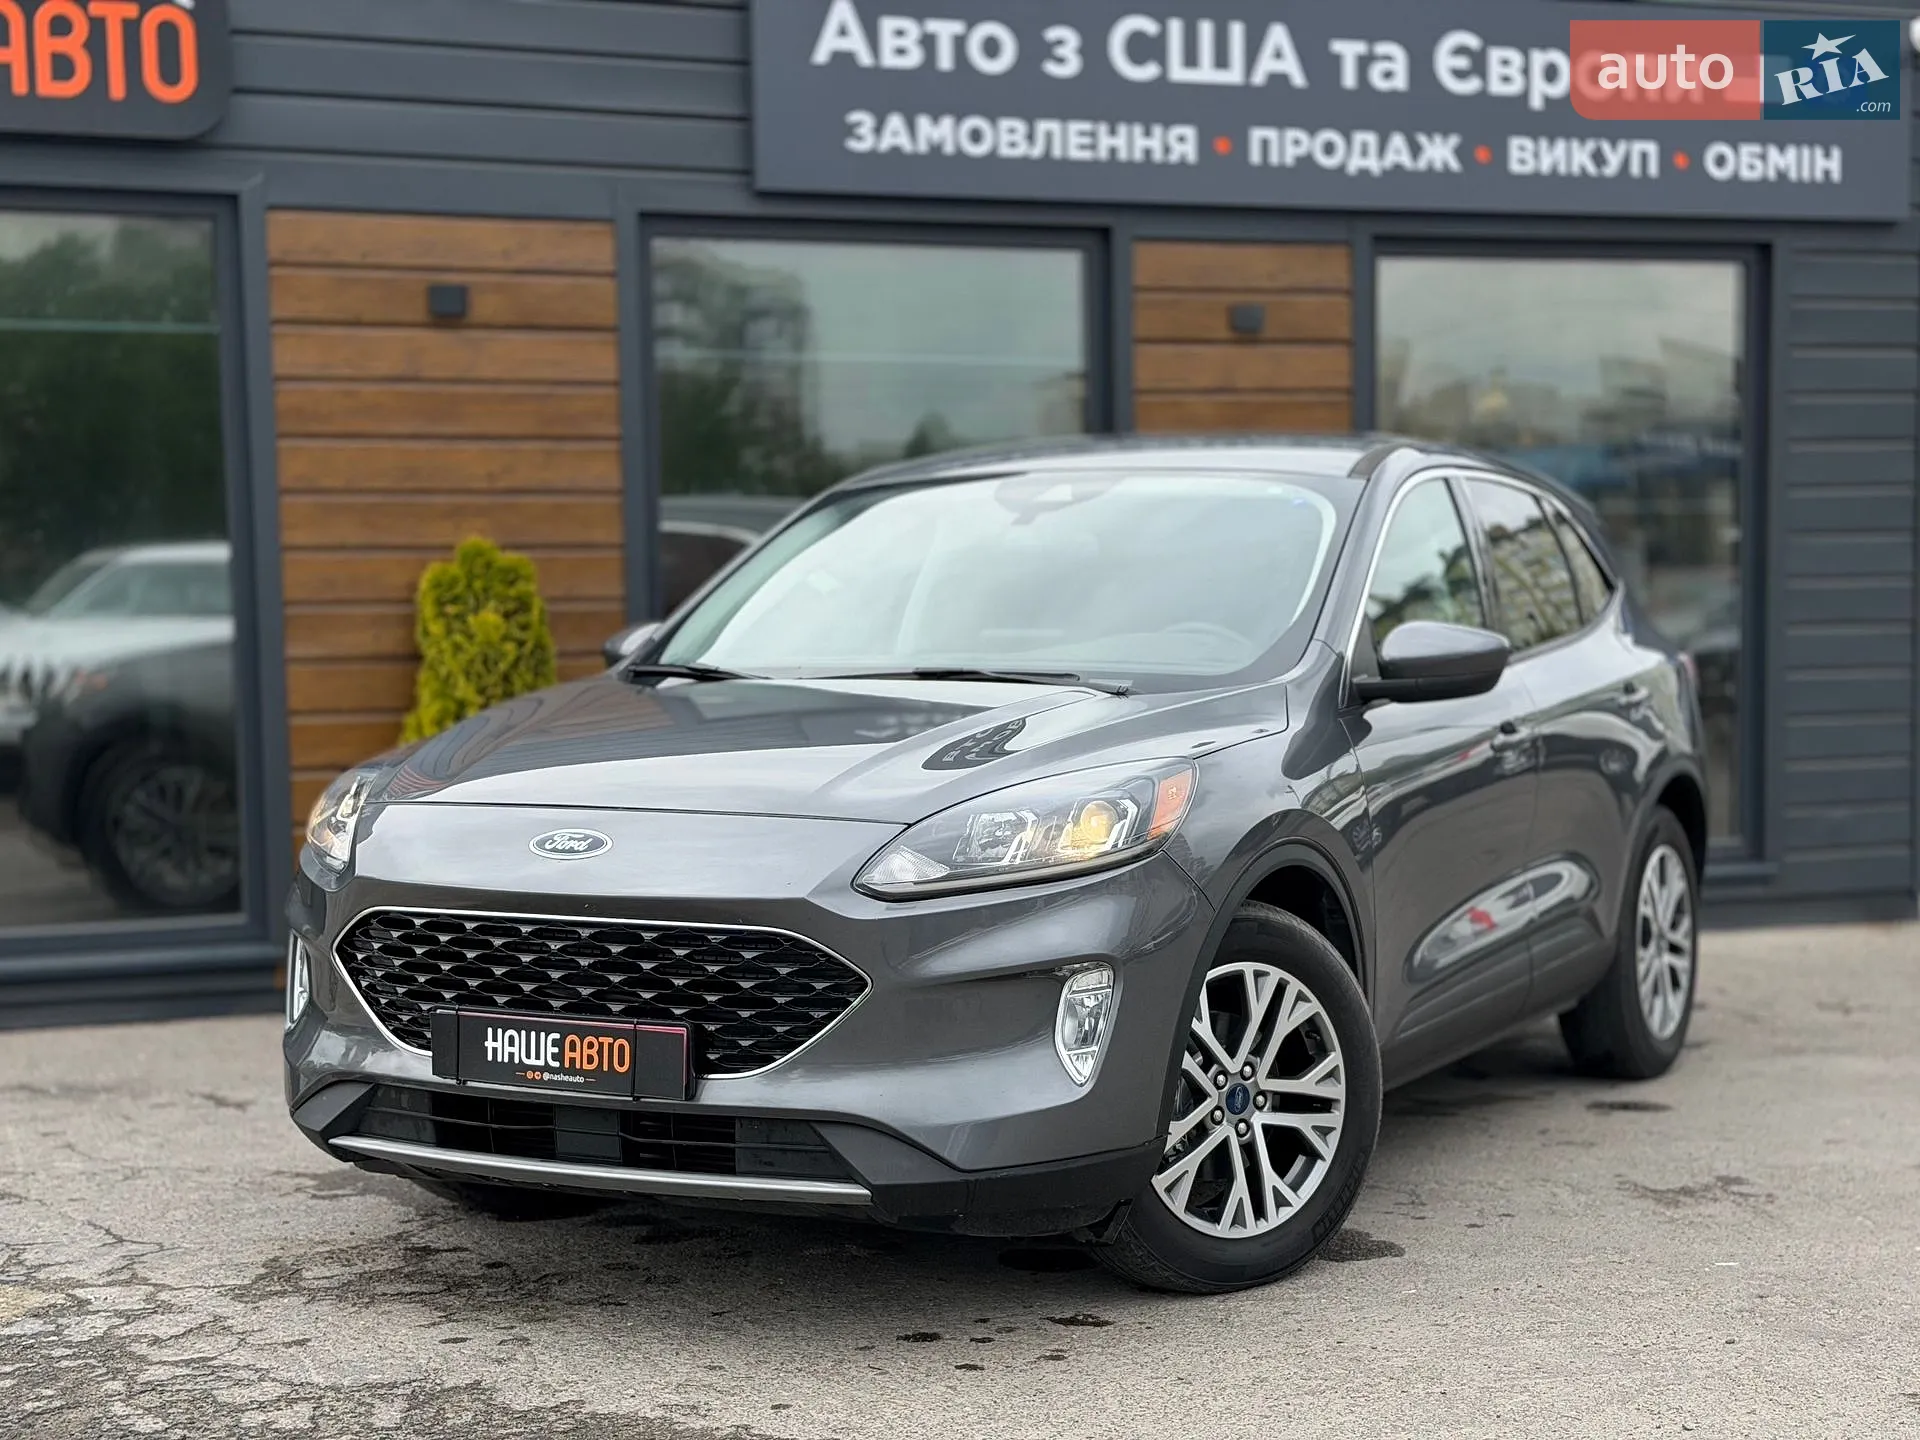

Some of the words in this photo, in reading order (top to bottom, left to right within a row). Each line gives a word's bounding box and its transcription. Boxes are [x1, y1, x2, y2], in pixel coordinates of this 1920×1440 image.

[810, 0, 1019, 75] Авто
[1040, 24, 1083, 78] з
[1106, 13, 1309, 89] США
[1329, 38, 1410, 91] та
[843, 110, 1198, 164] ЗАМОВЛЕННЯ
[1247, 126, 1462, 177] ПРОДАЖ
[1507, 135, 1660, 178] ВИКУП
[1703, 141, 1843, 183] ОБМІН
[544, 833, 593, 851] Ford
[543, 1072, 585, 1083] @nasheauto
